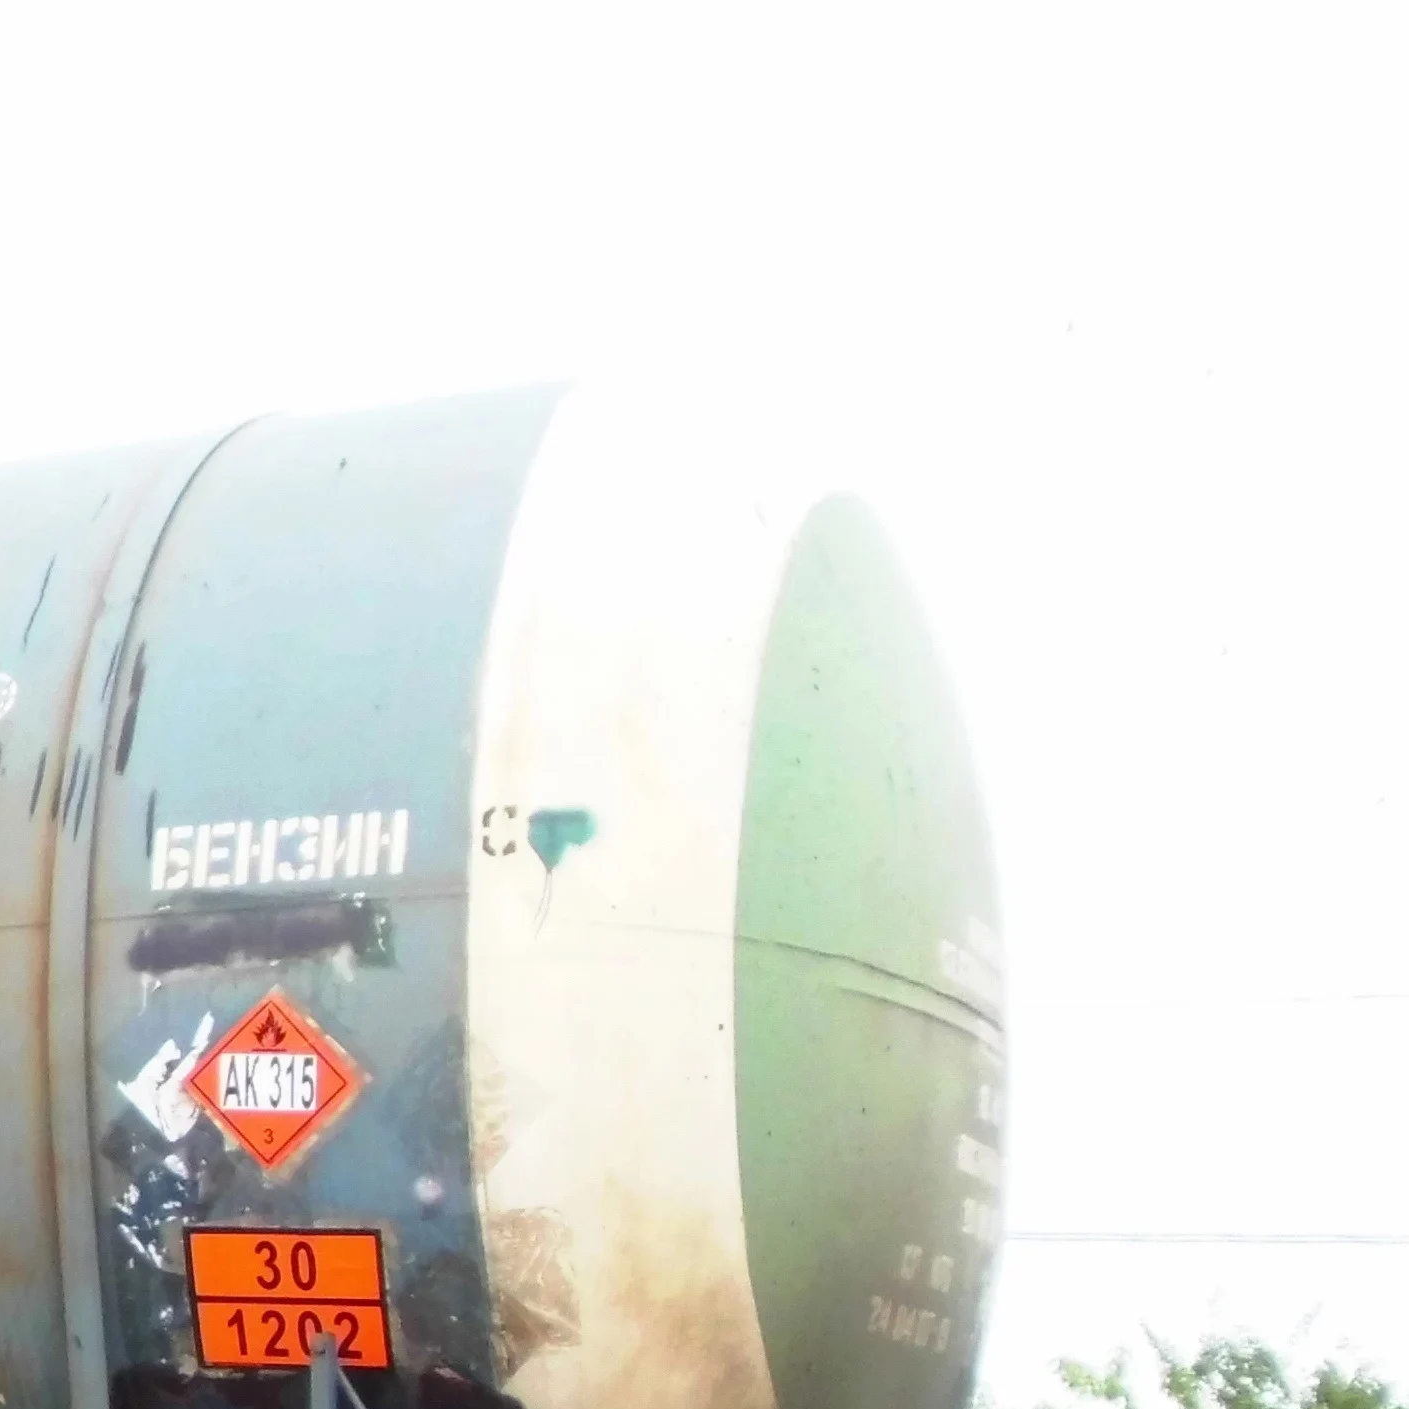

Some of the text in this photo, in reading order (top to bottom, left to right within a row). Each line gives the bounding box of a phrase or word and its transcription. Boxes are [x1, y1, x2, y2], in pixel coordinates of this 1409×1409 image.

[150, 809, 409, 891] БЕНЗИН
[223, 1055, 315, 1109] АК 315
[263, 1128, 275, 1145] 3
[254, 1240, 317, 1291] 30
[227, 1308, 363, 1359] 1202
